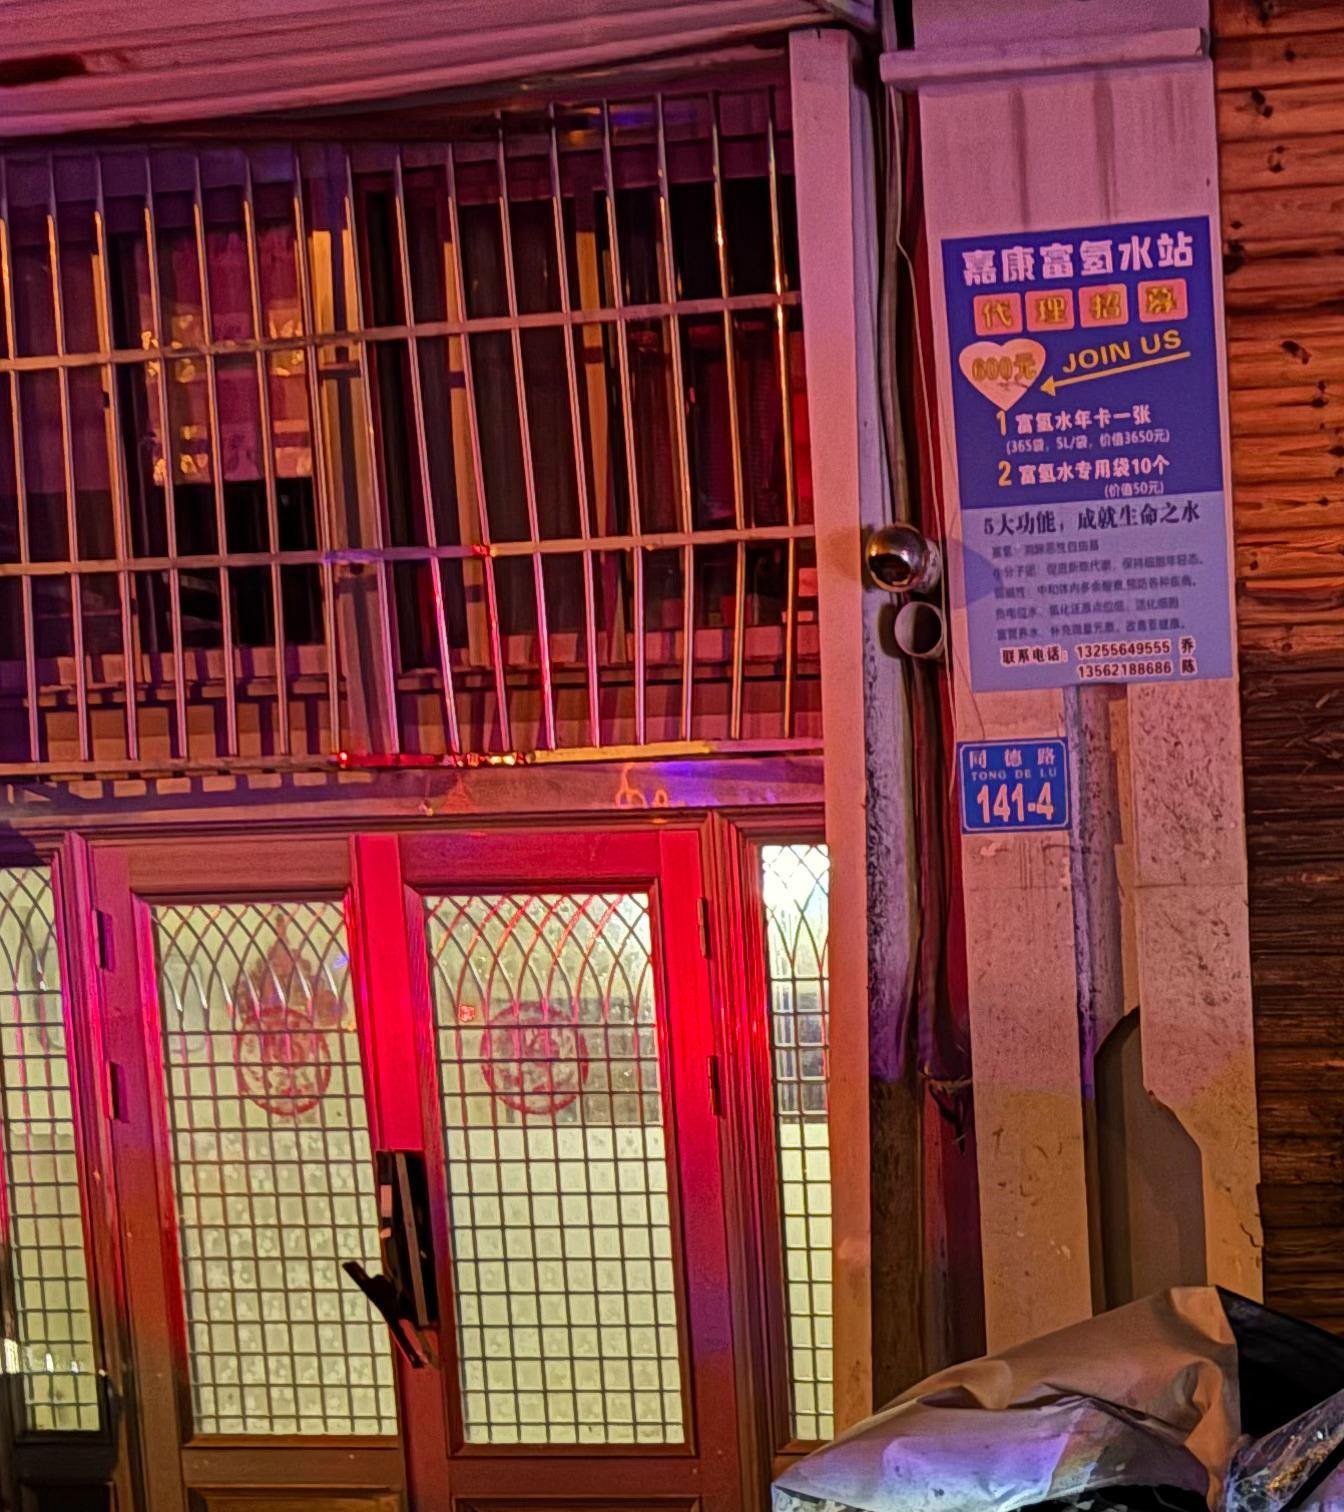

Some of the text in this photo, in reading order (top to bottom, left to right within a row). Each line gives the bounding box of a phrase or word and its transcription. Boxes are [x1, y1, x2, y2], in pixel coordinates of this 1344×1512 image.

[962, 231, 1193, 286] 嘉康富氢水站
[1062, 329, 1182, 374] JOIN US
[996, 404, 1152, 436] 1 富氢水年卡一张
[998, 454, 1170, 486] 2 富氢水专用袋10个
[1076, 640, 1171, 660] 13255649555
[1078, 661, 1173, 679] 13562188686
[971, 769, 1007, 781] TONG
[1015, 768, 1032, 780] DE
[976, 781, 1054, 824] 141-4
